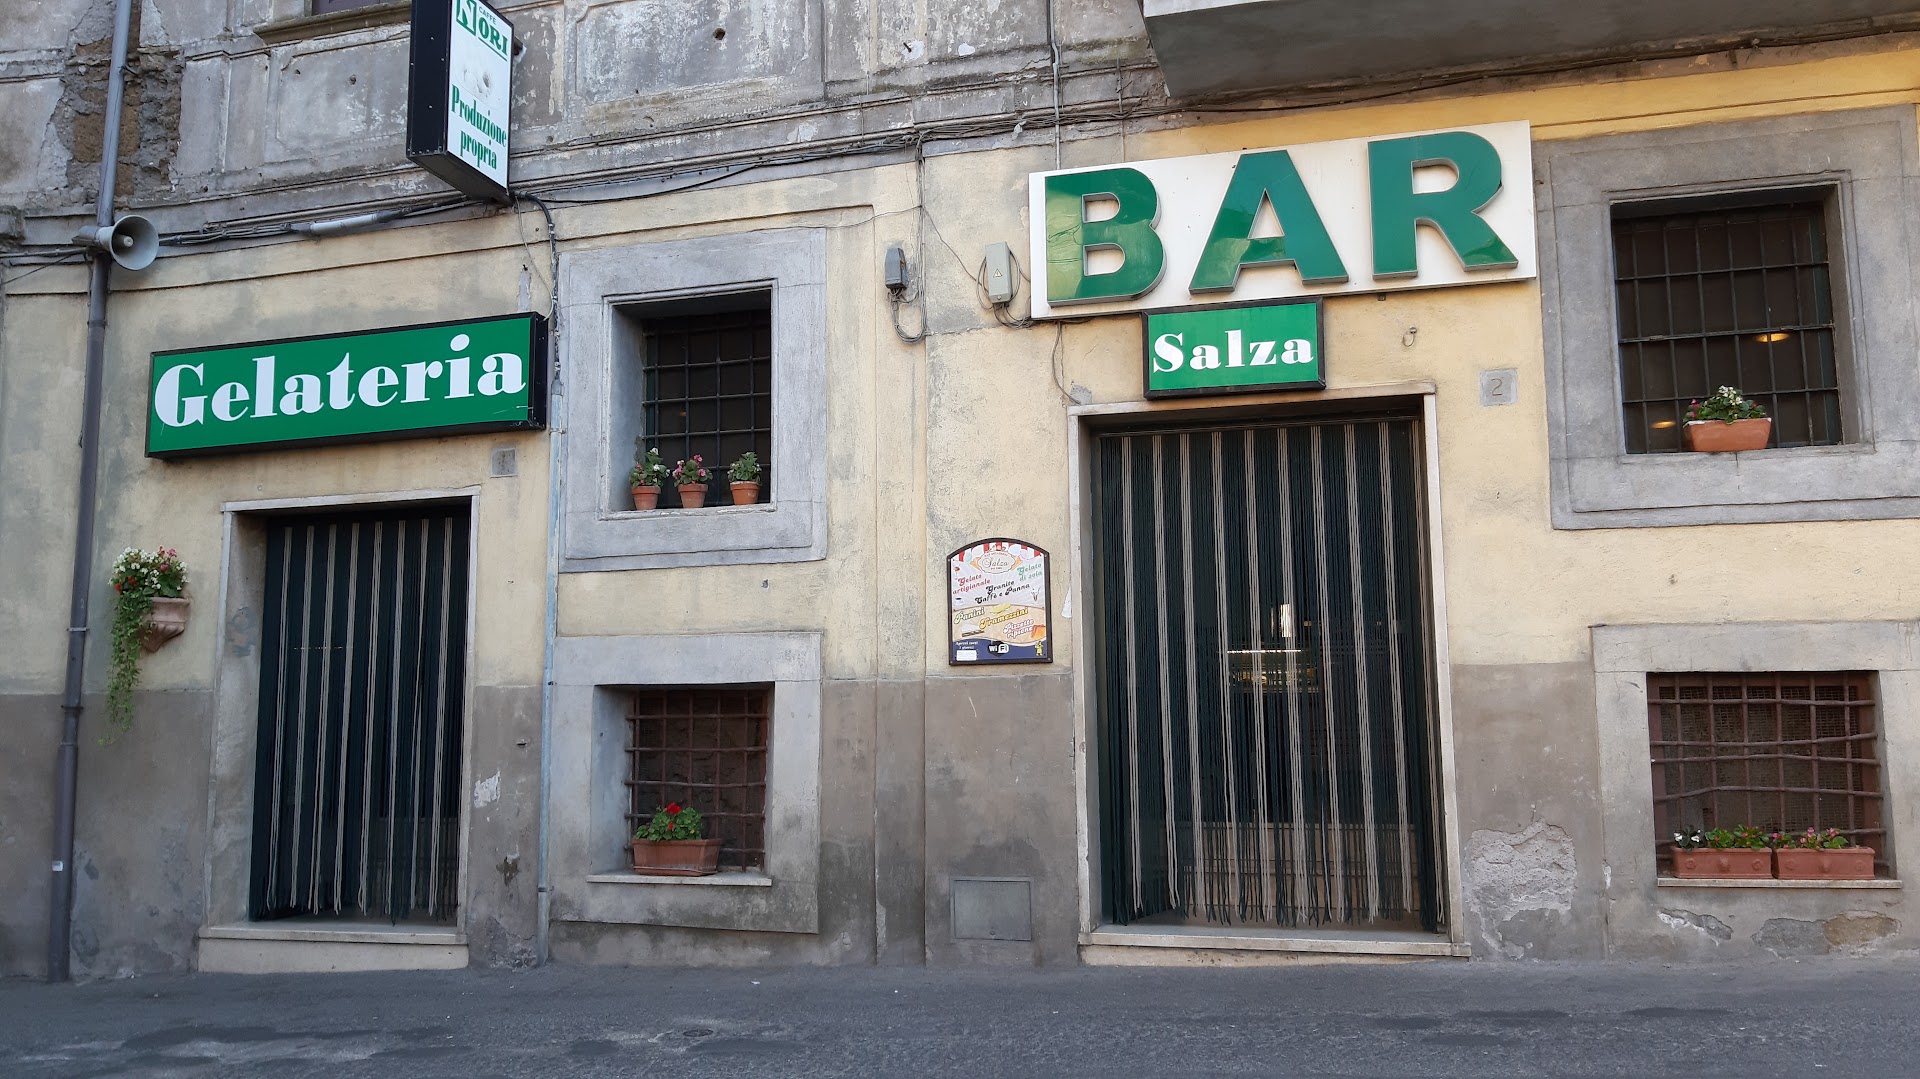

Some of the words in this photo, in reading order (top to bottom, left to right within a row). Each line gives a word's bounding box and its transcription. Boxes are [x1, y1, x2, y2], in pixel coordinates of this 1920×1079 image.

[451, 84, 507, 148] Produzione
[460, 129, 497, 170] propria
[1045, 131, 1520, 307] BAR
[1152, 328, 1314, 374] Salza
[154, 333, 526, 428] Gelateria
[1491, 378, 1503, 396] 2
[957, 573, 982, 587] Gelato
[1017, 563, 1042, 576] Gelato
[952, 578, 991, 595] artigianale
[1005, 583, 1030, 596] Panna
[953, 607, 985, 624] Panini
[979, 606, 1029, 630] Tramezzini
